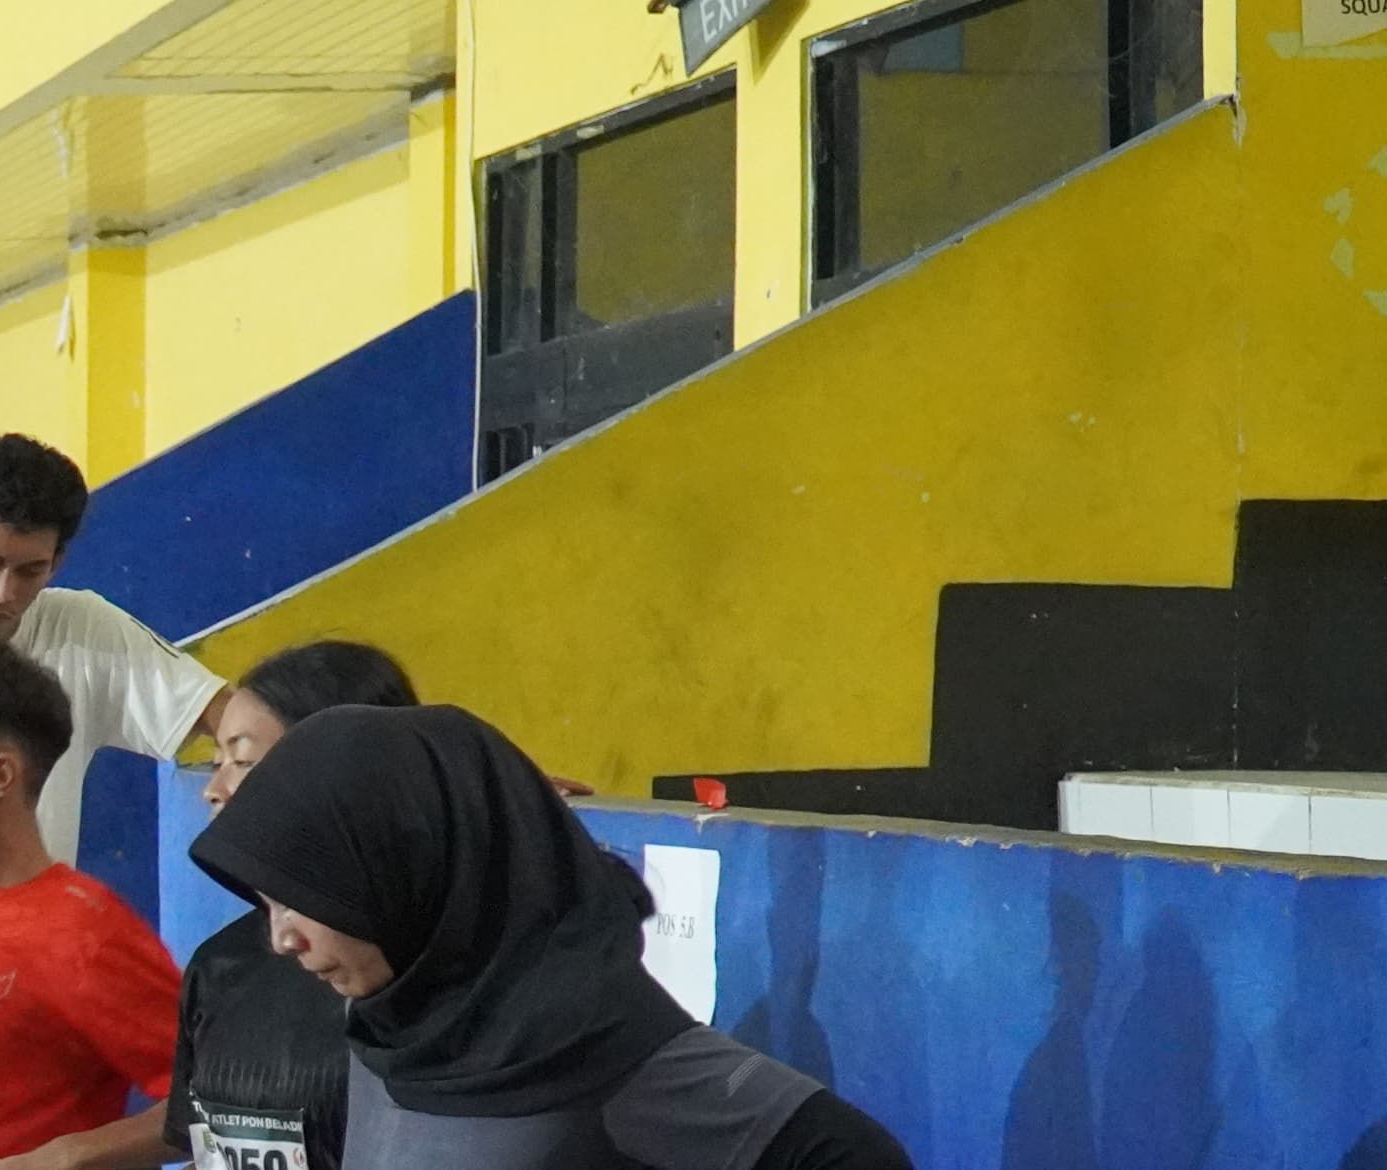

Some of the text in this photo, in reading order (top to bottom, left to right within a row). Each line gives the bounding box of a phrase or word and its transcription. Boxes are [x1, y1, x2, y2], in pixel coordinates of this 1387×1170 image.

[1341, 0, 1387, 16] SQU
[700, 0, 747, 43] EX
[242, 1116, 264, 1128] PON
